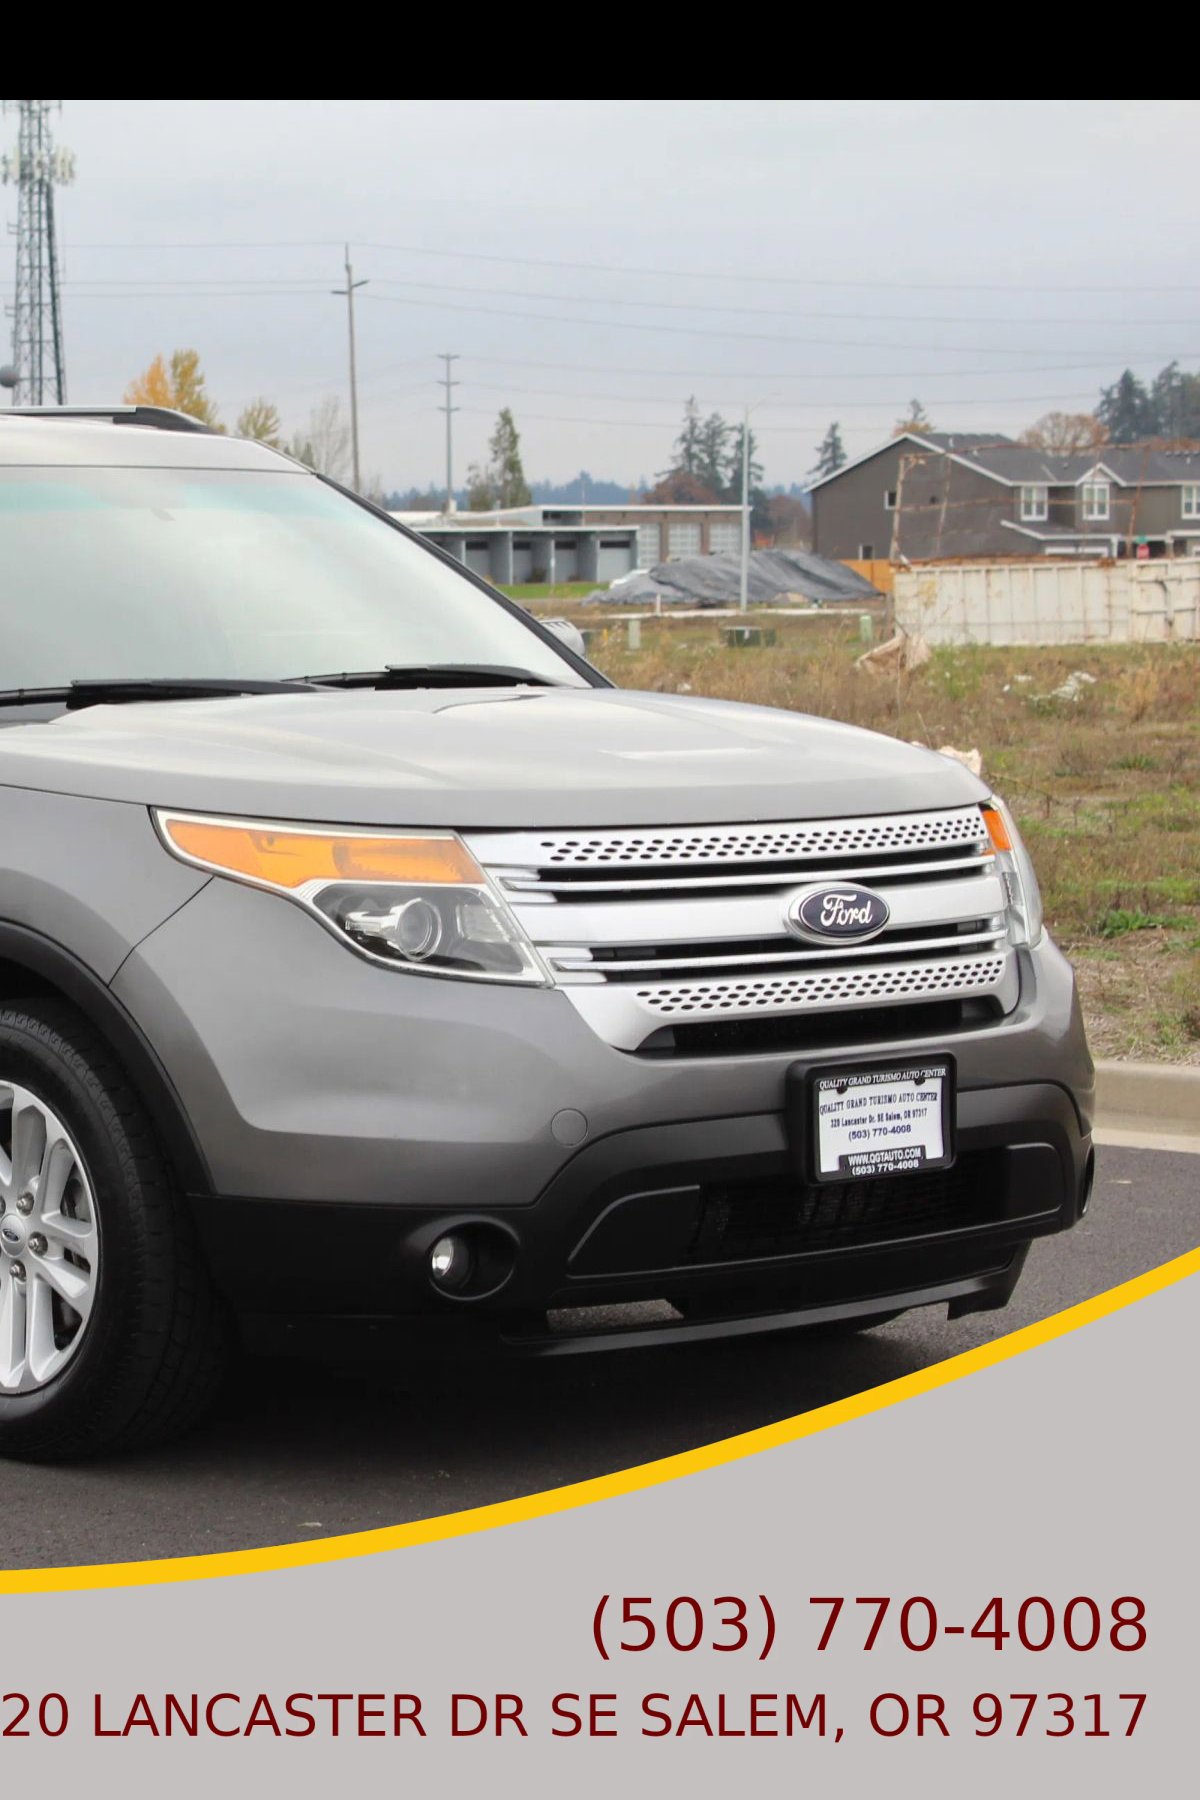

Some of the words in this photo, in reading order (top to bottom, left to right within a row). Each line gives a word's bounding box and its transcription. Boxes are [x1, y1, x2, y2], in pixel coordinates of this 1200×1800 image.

[820, 894, 873, 927] Ford
[819, 1078, 848, 1090] QUALITY
[848, 1075, 872, 1086] GRAND
[872, 1072, 901, 1084] TURISMO
[901, 1070, 920, 1081] AUTO
[920, 1068, 946, 1078] CENTER
[819, 1101, 844, 1115] QUALITY
[846, 1097, 867, 1110] GRAND
[868, 1094, 897, 1106] TURISMO
[898, 1093, 915, 1104] AUTO
[915, 1092, 938, 1102] CENTER
[841, 1115, 868, 1127] Lancaster
[877, 1112, 885, 1122] SE
[903, 1109, 911, 1119] OR
[848, 1128, 870, 1142] (503)
[872, 1124, 912, 1137] 770-4008
[848, 1147, 921, 1167] WWW.QGTAUTO.COM
[851, 1163, 876, 1176] (503)
[876, 1158, 919, 1172] 770-4008
